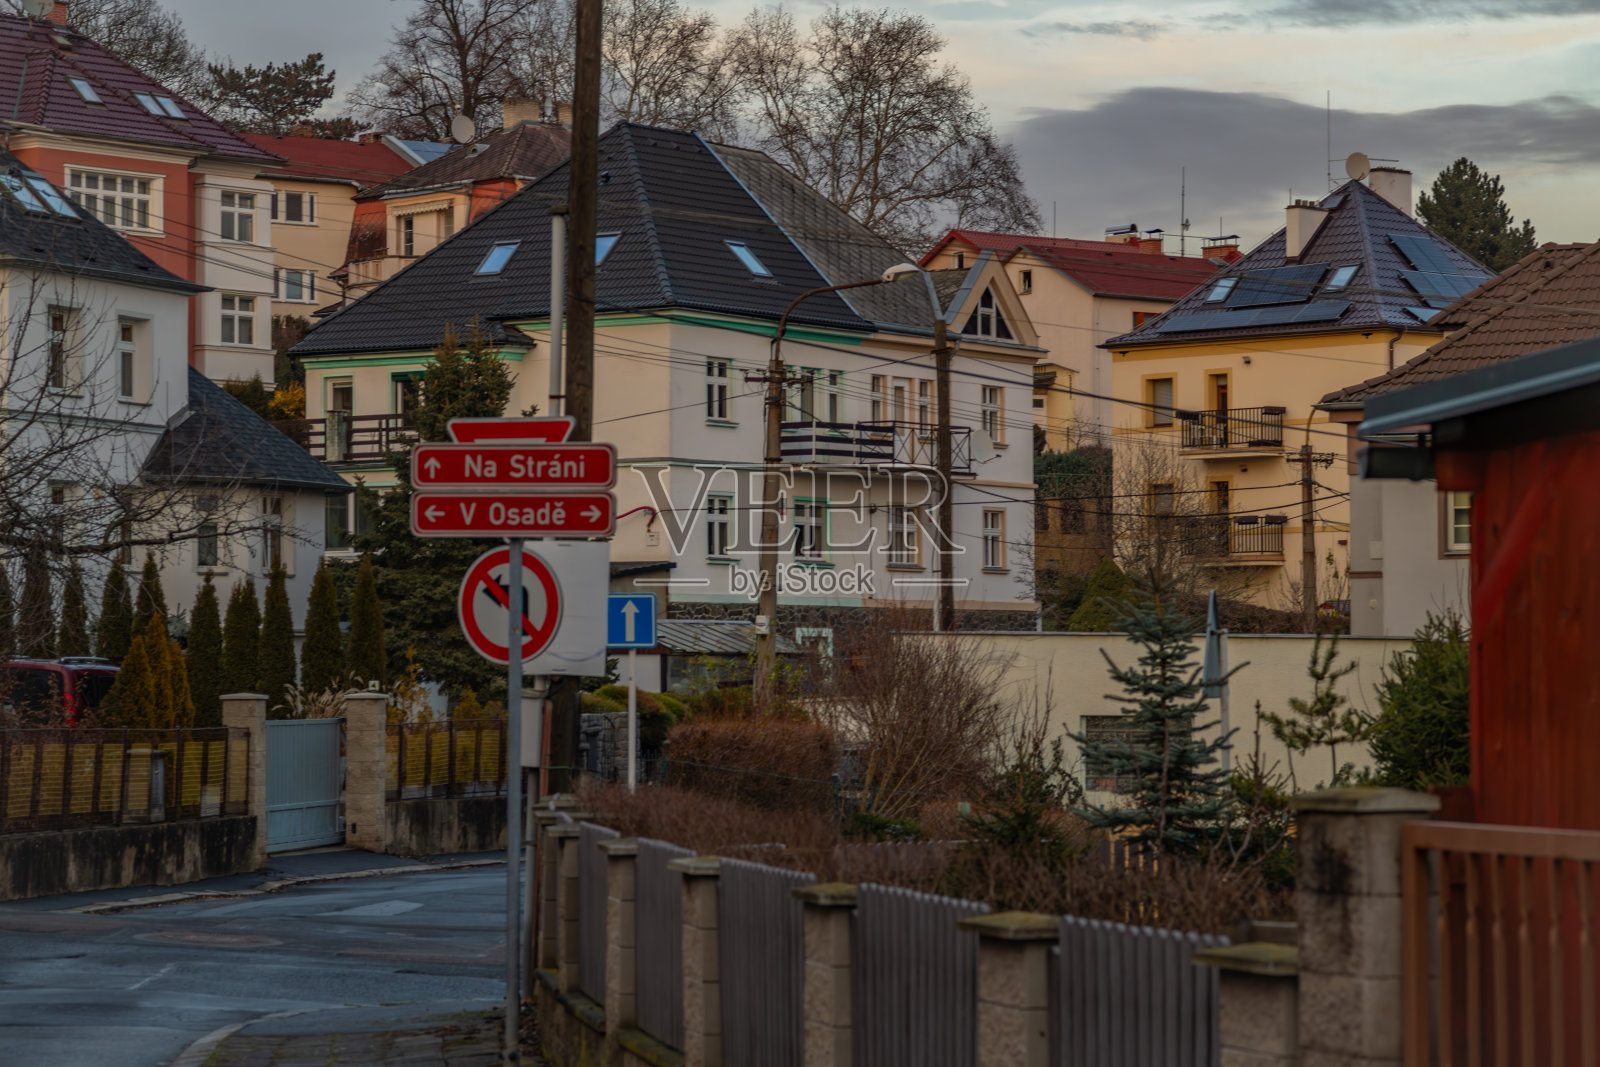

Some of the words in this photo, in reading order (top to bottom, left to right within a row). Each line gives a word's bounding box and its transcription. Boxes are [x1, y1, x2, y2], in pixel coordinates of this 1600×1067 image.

[464, 454, 498, 478] Na
[509, 453, 585, 478] Stráni
[459, 502, 477, 526] V
[489, 501, 567, 526] Osadě
